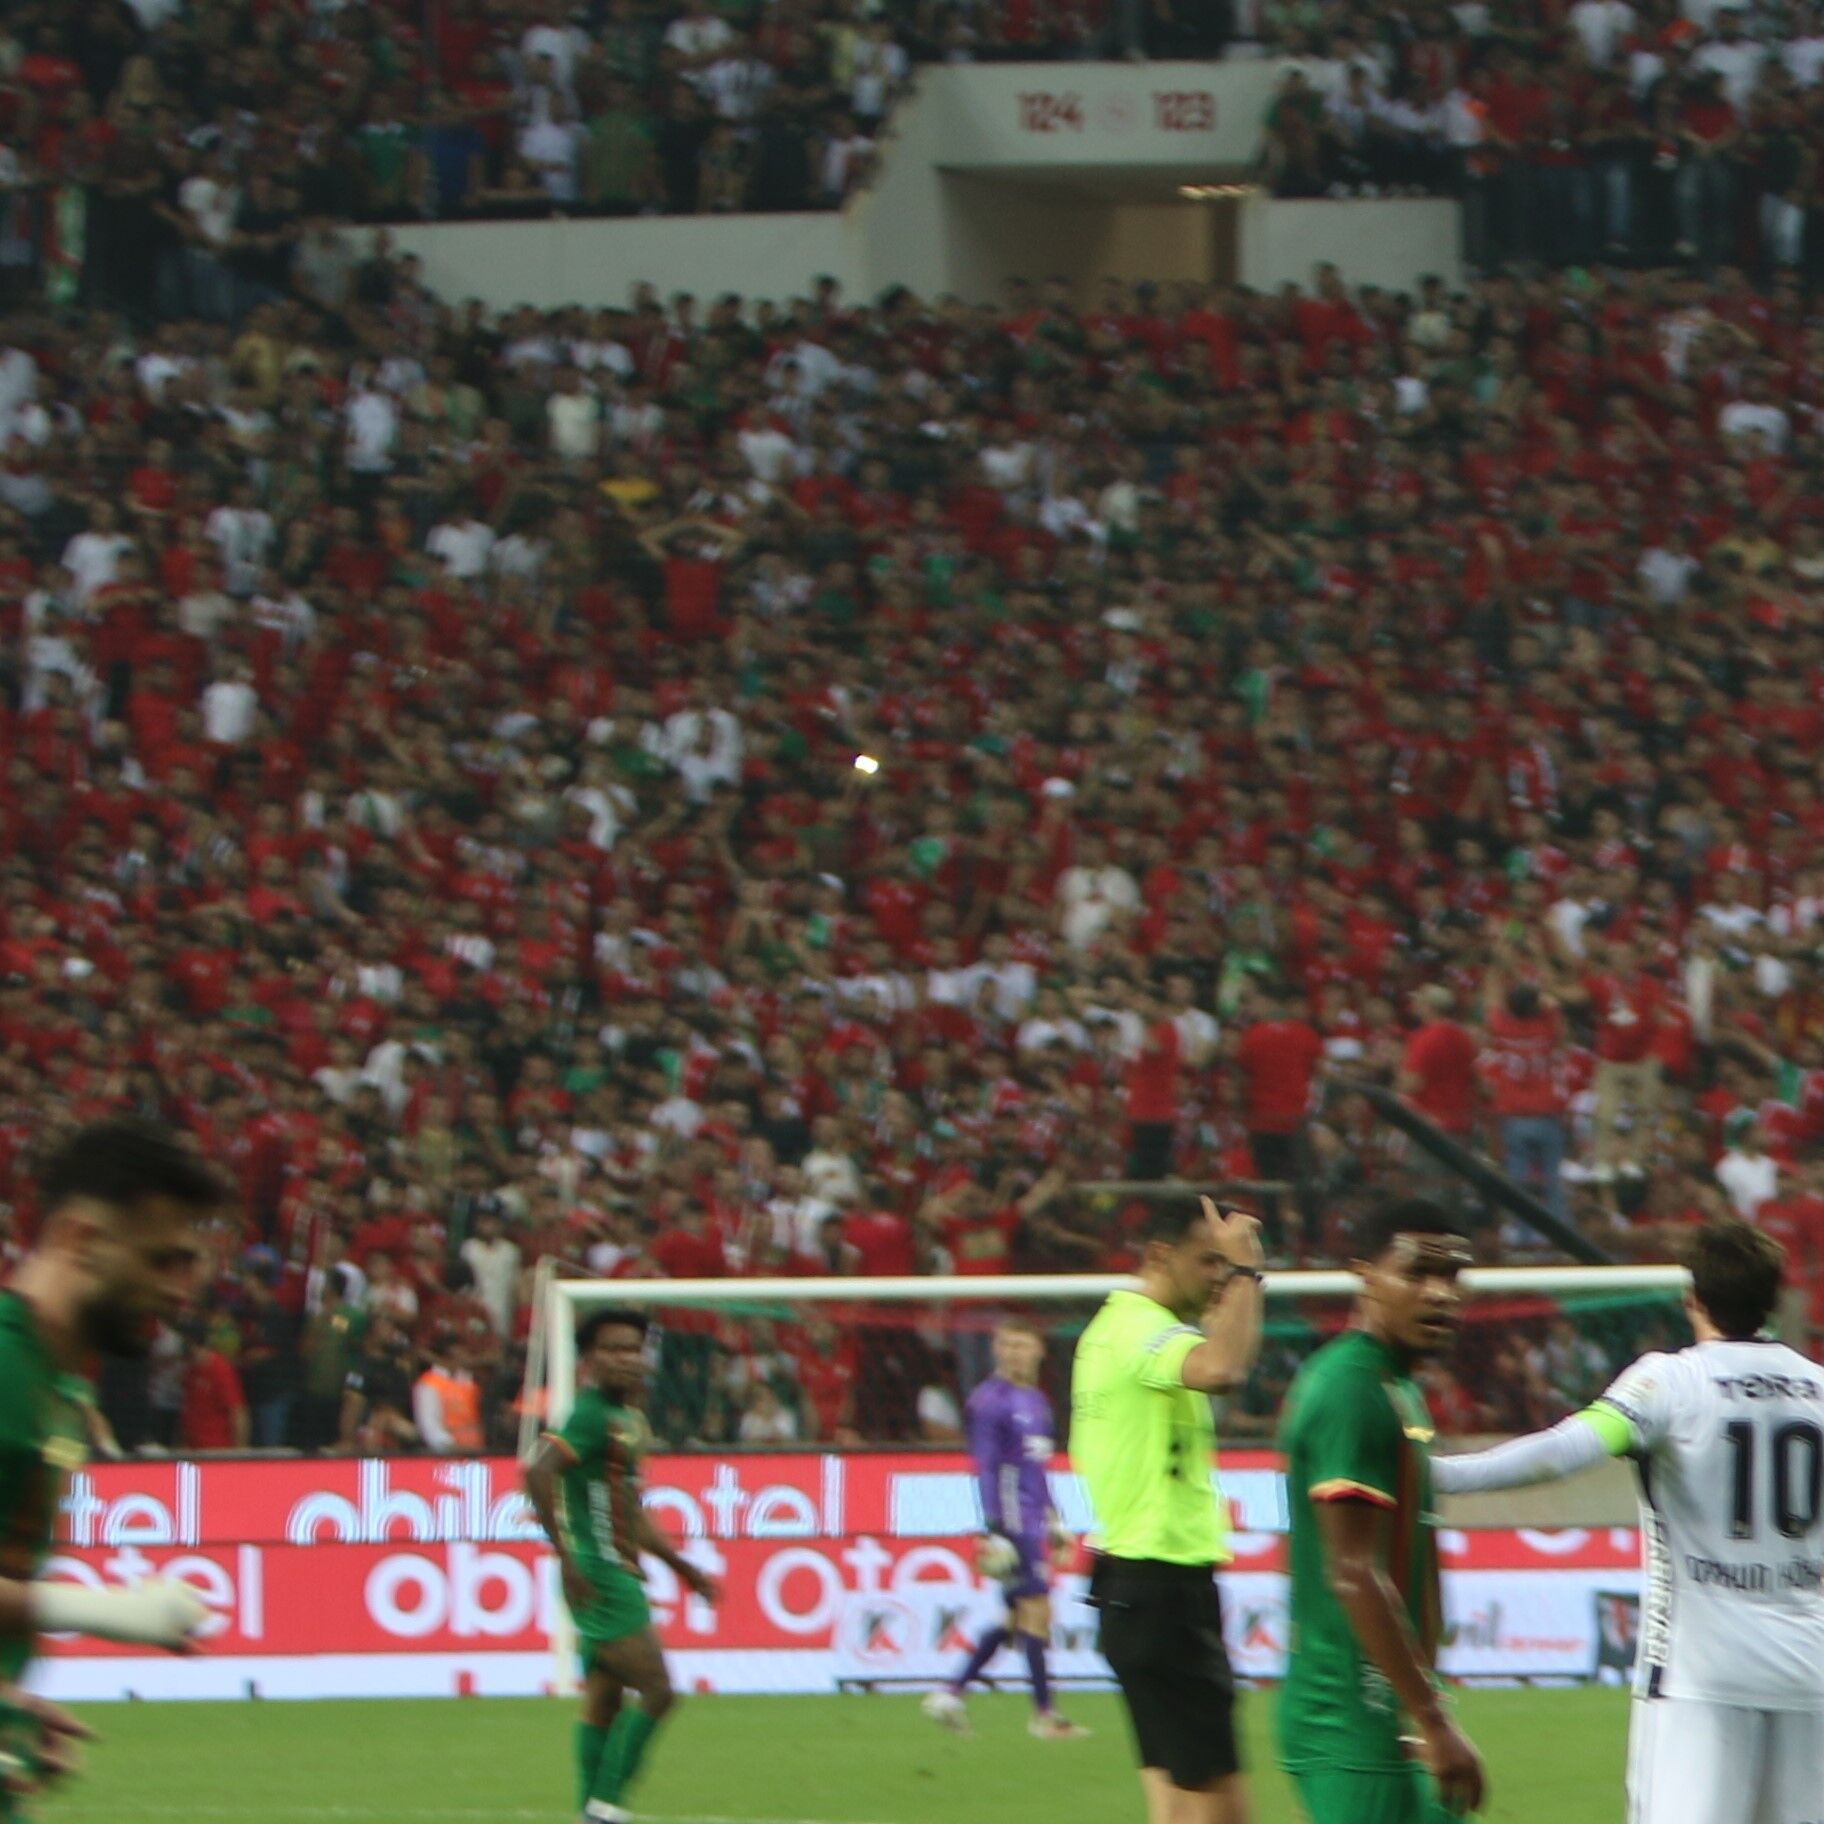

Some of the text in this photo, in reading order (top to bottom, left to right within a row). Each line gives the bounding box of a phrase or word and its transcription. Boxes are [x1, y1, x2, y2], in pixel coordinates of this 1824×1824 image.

[55, 1460, 201, 1546] tel
[287, 1457, 547, 1543] obile
[1722, 1419, 1824, 1541] 10
